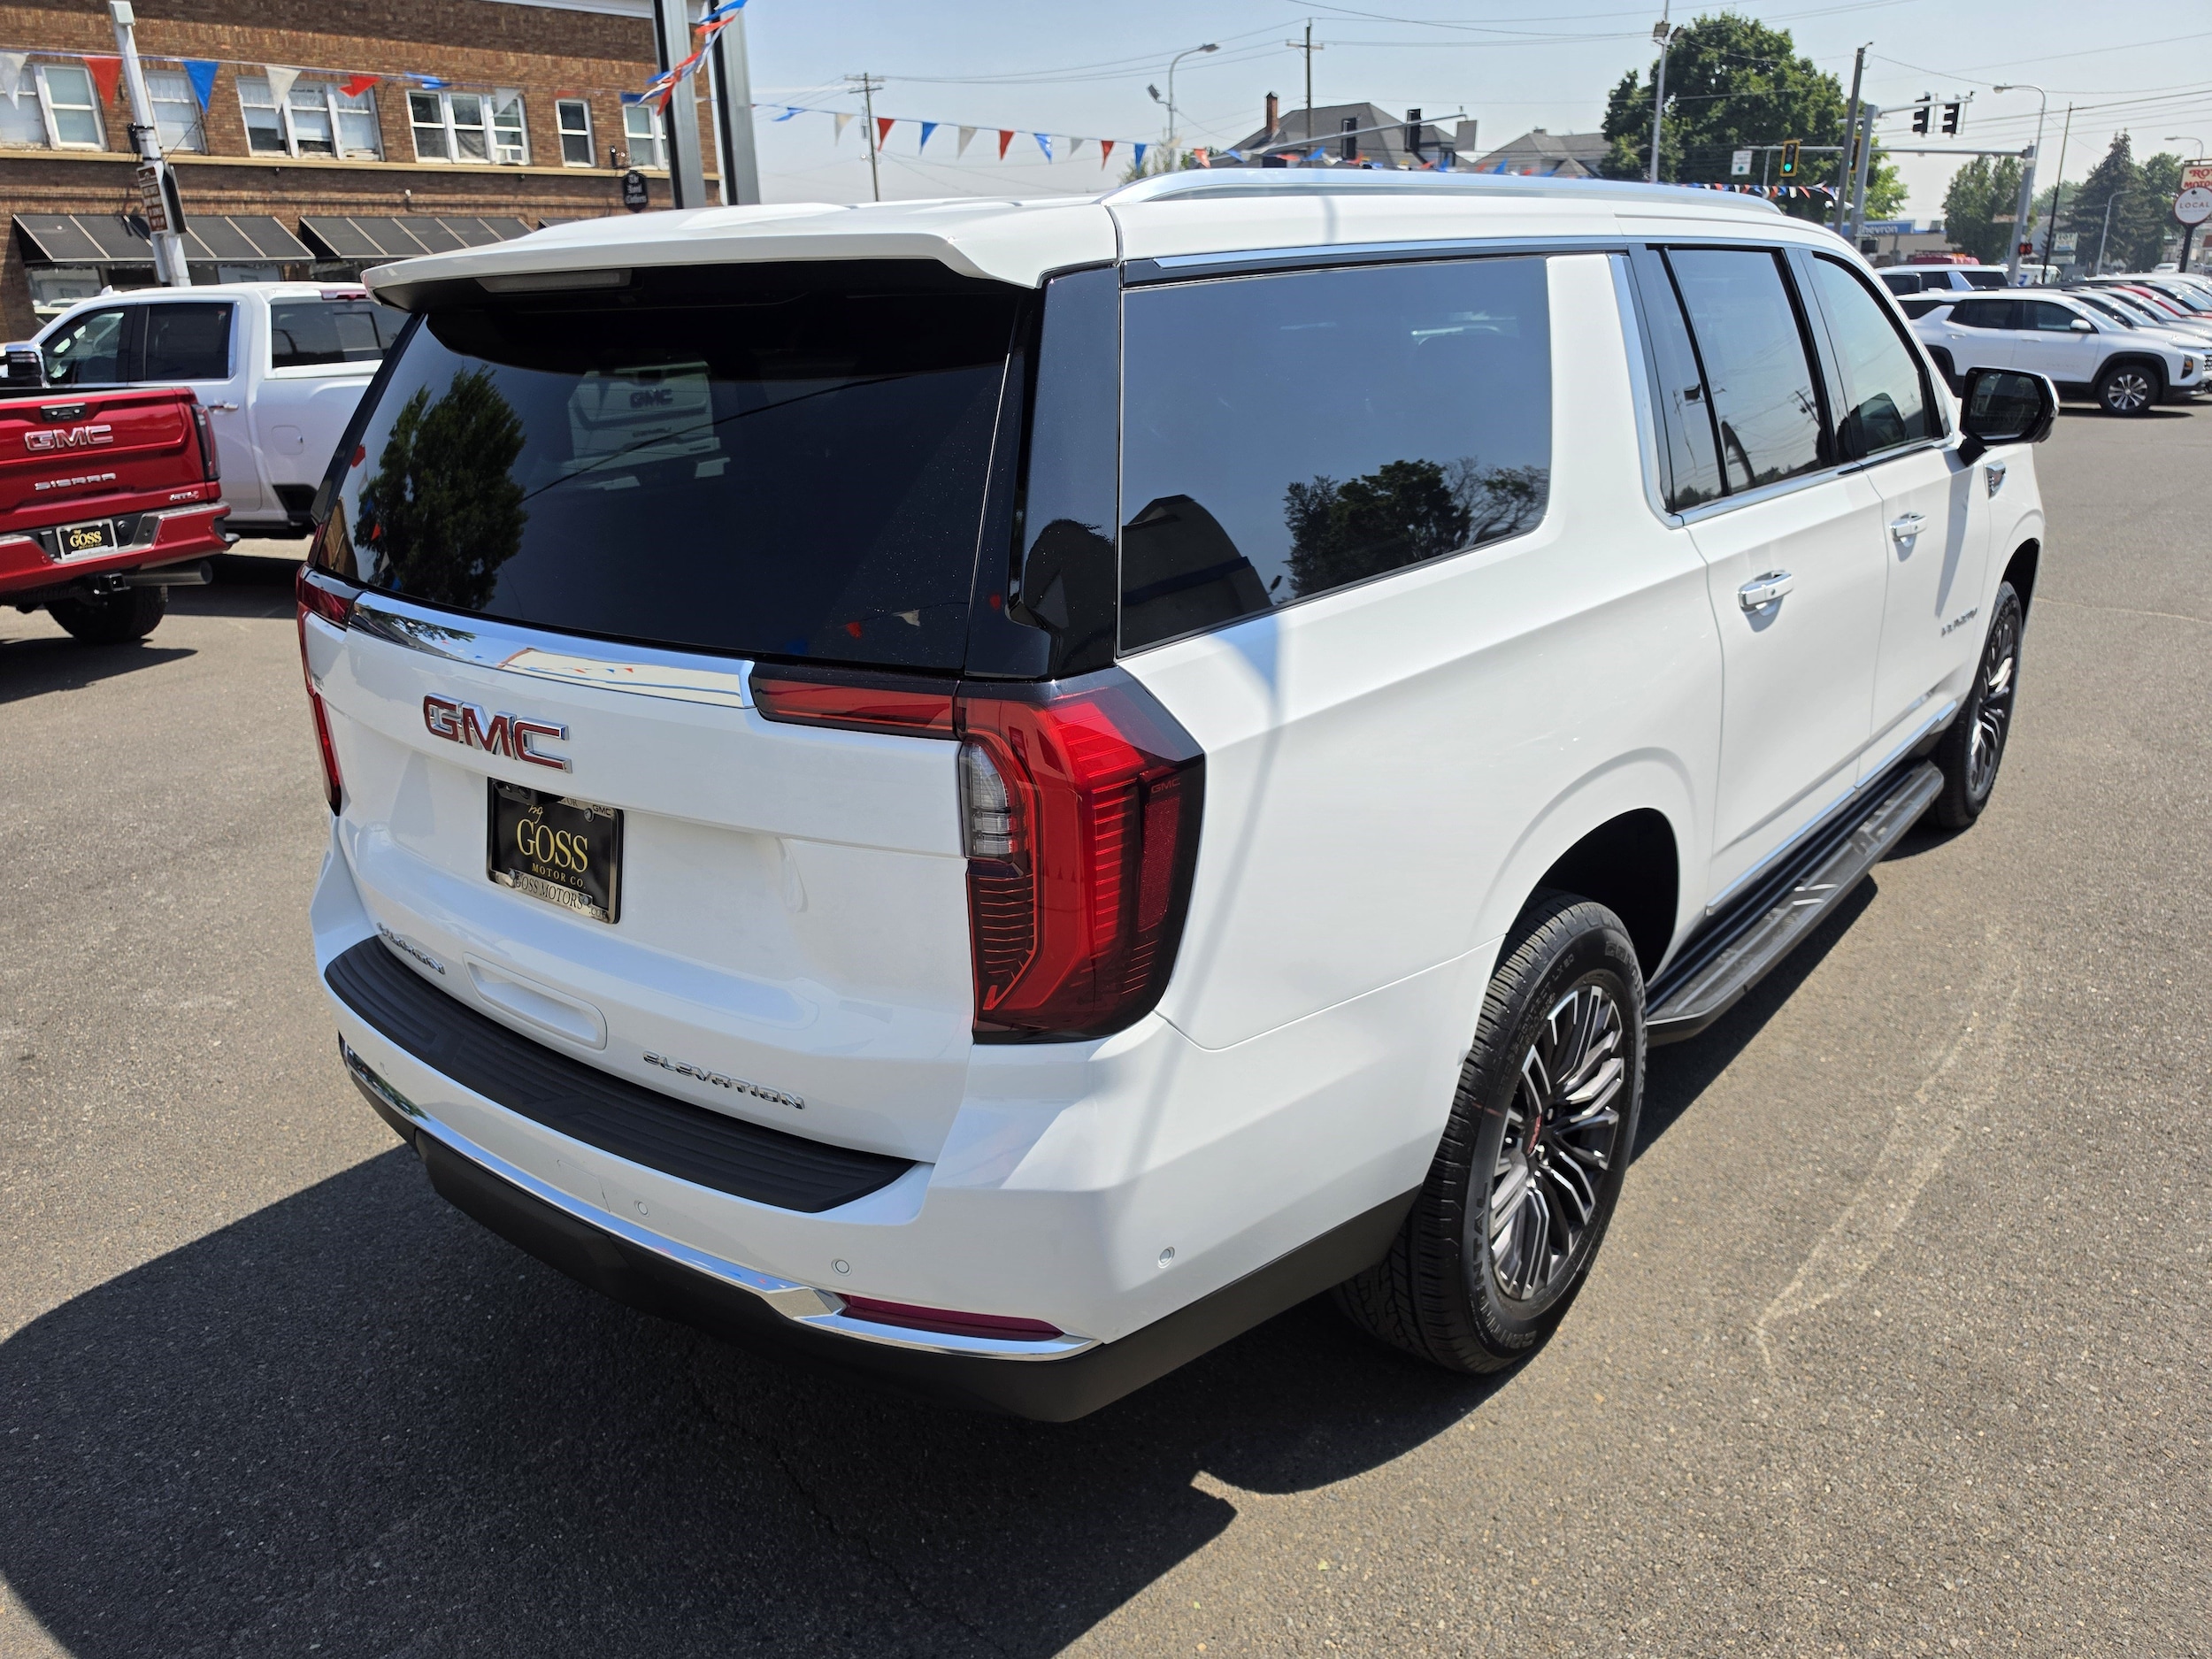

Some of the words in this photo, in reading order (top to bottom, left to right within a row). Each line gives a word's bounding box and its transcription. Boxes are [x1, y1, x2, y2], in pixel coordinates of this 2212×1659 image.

[2189, 168, 2212, 180] RO
[1861, 224, 1899, 234] hevron
[630, 389, 673, 408] GMC
[25, 425, 114, 451] GMC
[35, 472, 117, 491] SIERRA
[70, 531, 102, 547] GOSS
[423, 692, 573, 774] GMC
[1151, 778, 1180, 794] GMC
[593, 804, 612, 816] GMC
[517, 818, 588, 873] GOSS
[532, 863, 566, 883] MOTOR
[570, 876, 587, 889] CO.
[515, 872, 538, 894] GOSS
[540, 882, 583, 910] MOTORS
[376, 922, 446, 975] YUKON
[643, 1050, 805, 1110] ELEVATION
